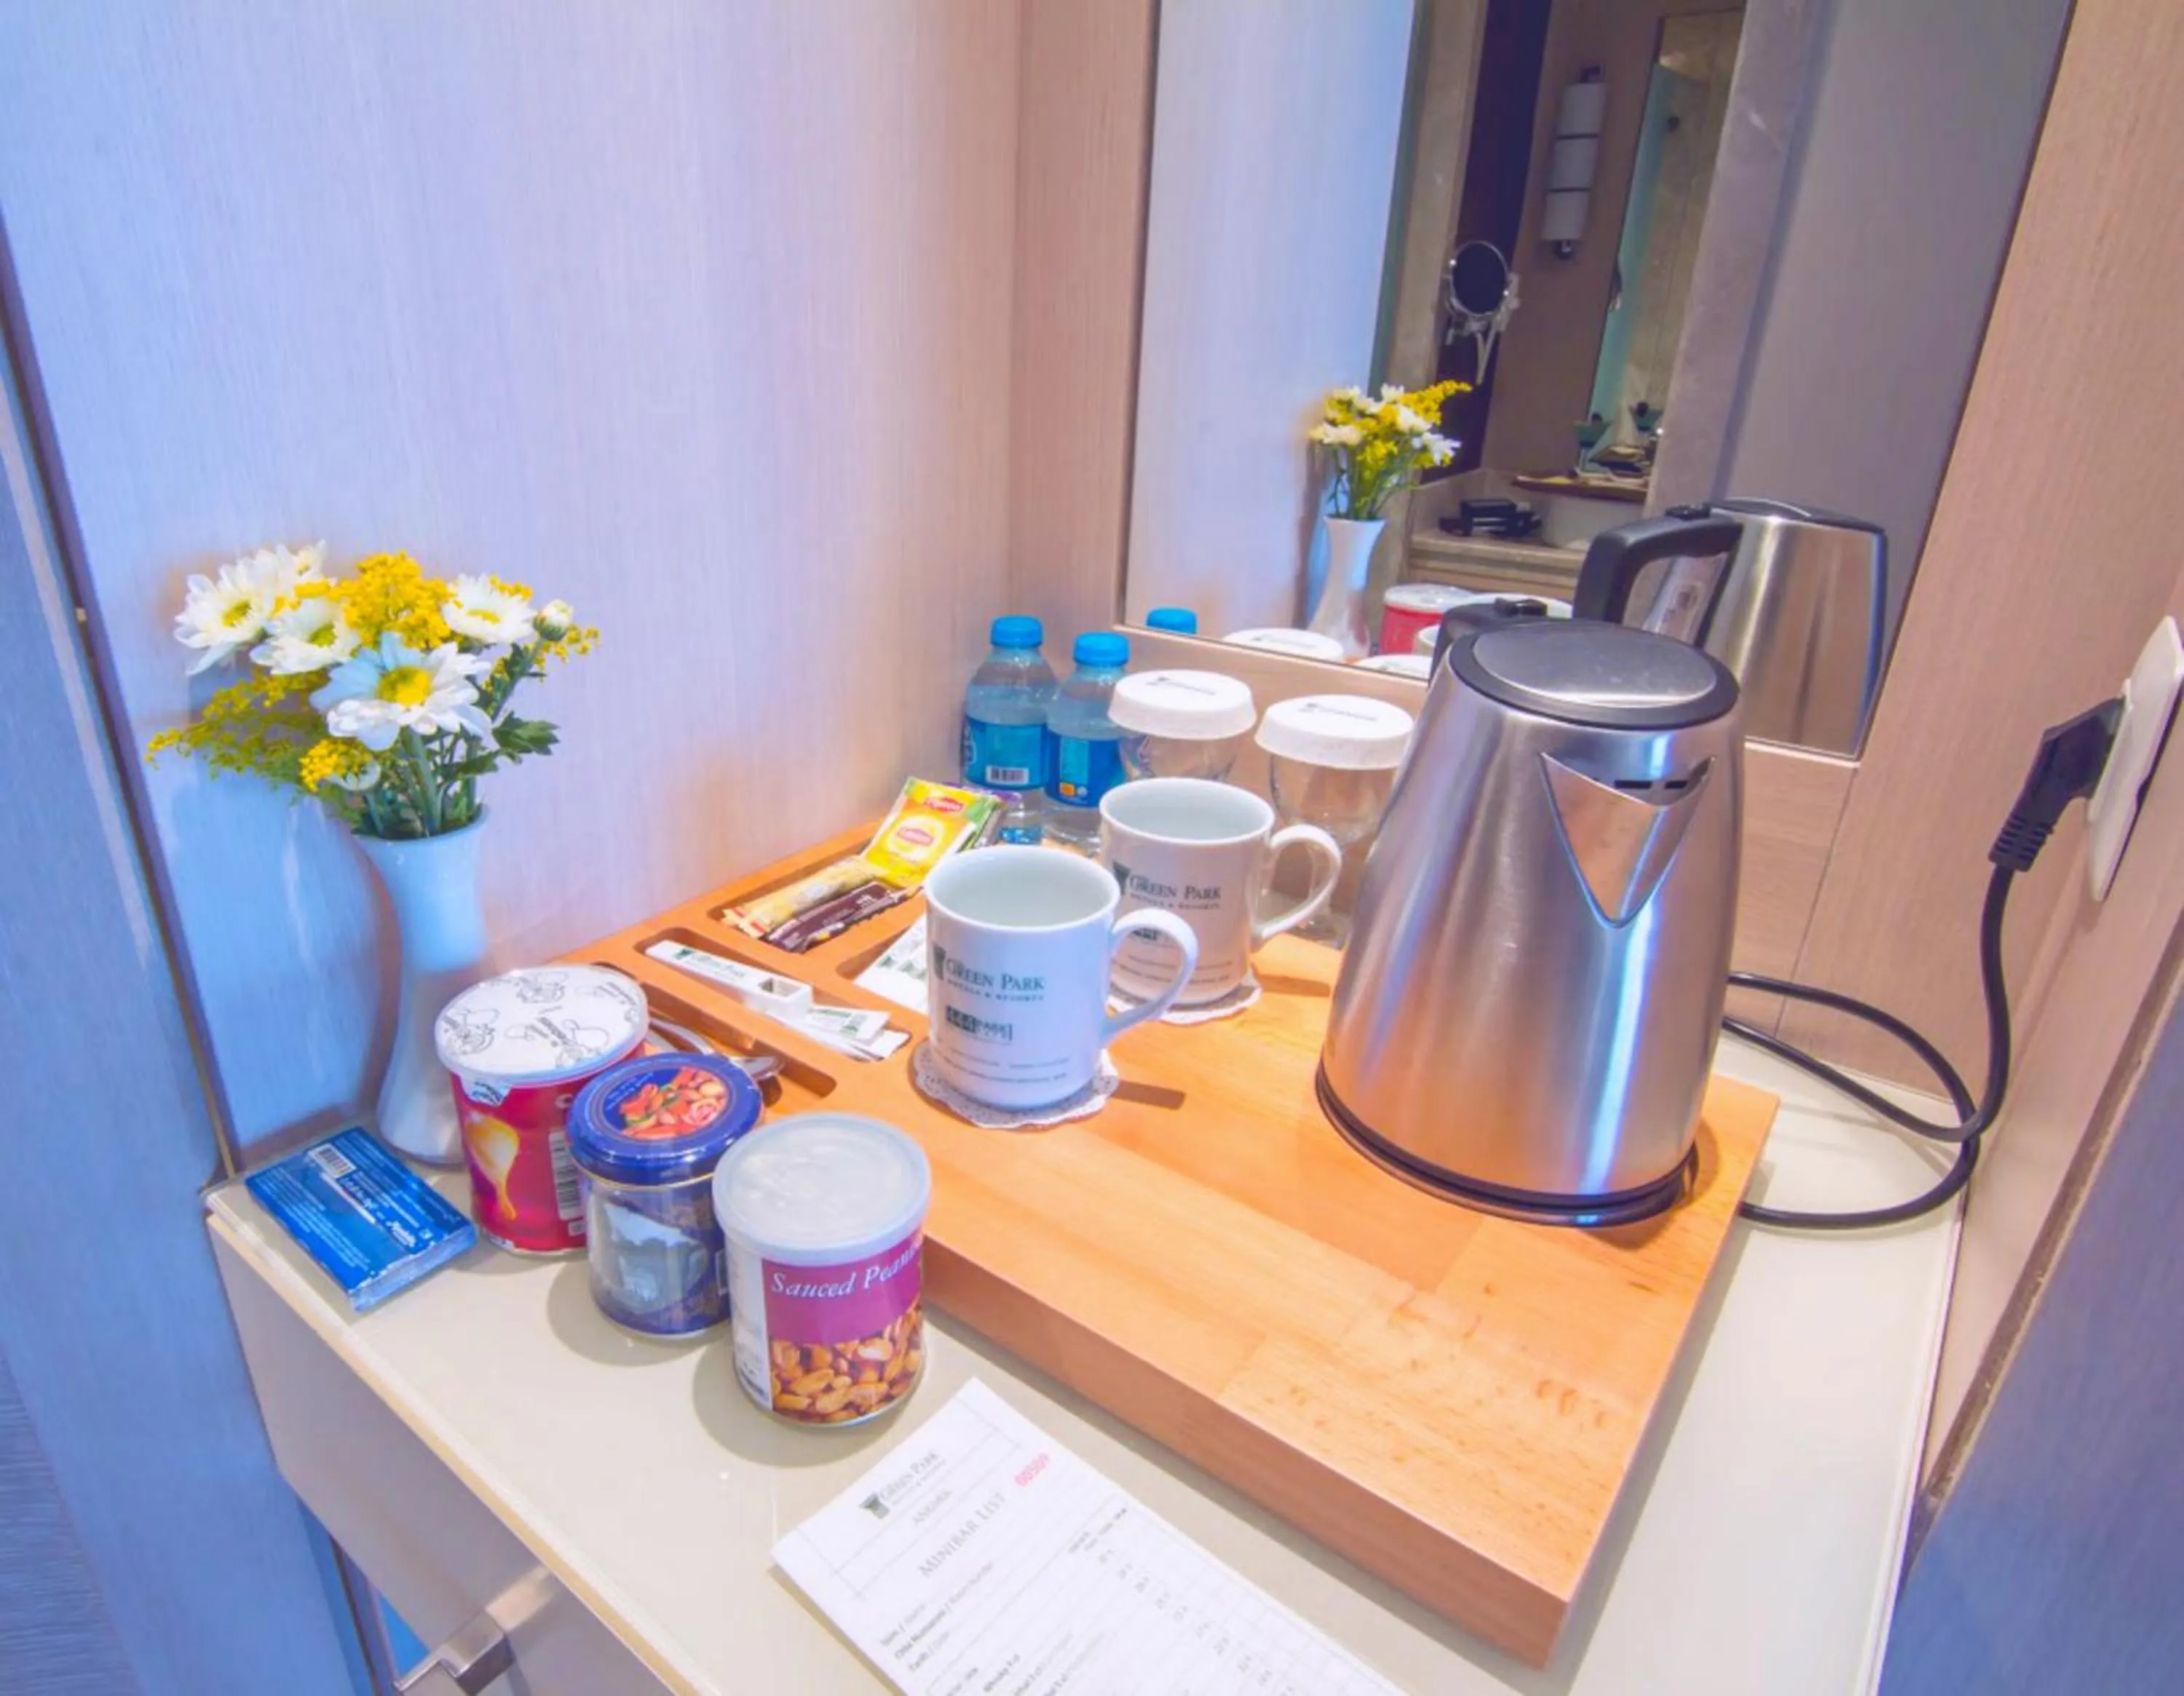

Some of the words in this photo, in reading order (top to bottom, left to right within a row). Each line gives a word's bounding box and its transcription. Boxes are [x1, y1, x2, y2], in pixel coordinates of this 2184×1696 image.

[1130, 874, 1177, 897] GREEN
[1184, 885, 1221, 900] PARK
[946, 958, 994, 987] GREEN
[1001, 973, 1045, 991] PARK
[770, 1271, 856, 1297] Sauced
[863, 1242, 919, 1289] Peanu
[919, 1519, 979, 1577] MINIBAR
